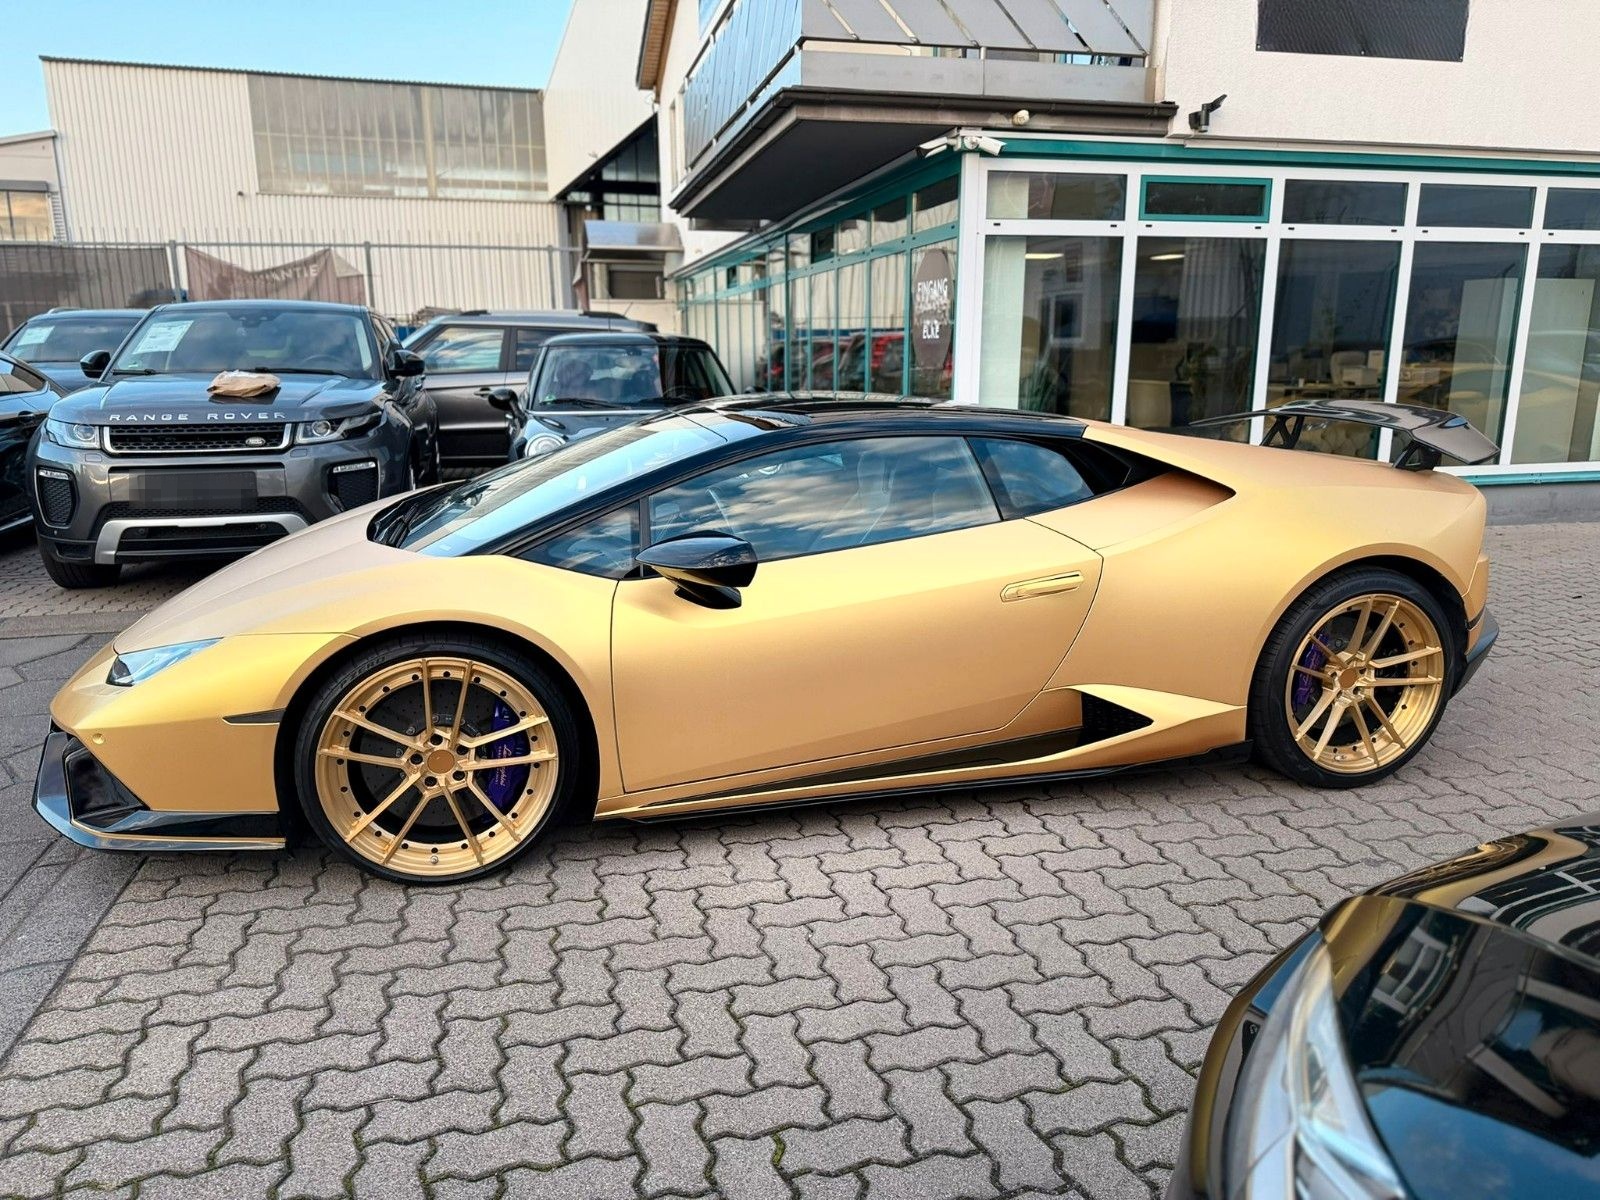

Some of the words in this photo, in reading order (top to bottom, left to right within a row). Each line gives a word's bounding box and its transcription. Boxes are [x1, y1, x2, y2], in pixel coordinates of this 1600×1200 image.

[917, 278, 948, 299] EINGANG
[109, 413, 189, 421] RANGE
[207, 412, 286, 420] ROVER
